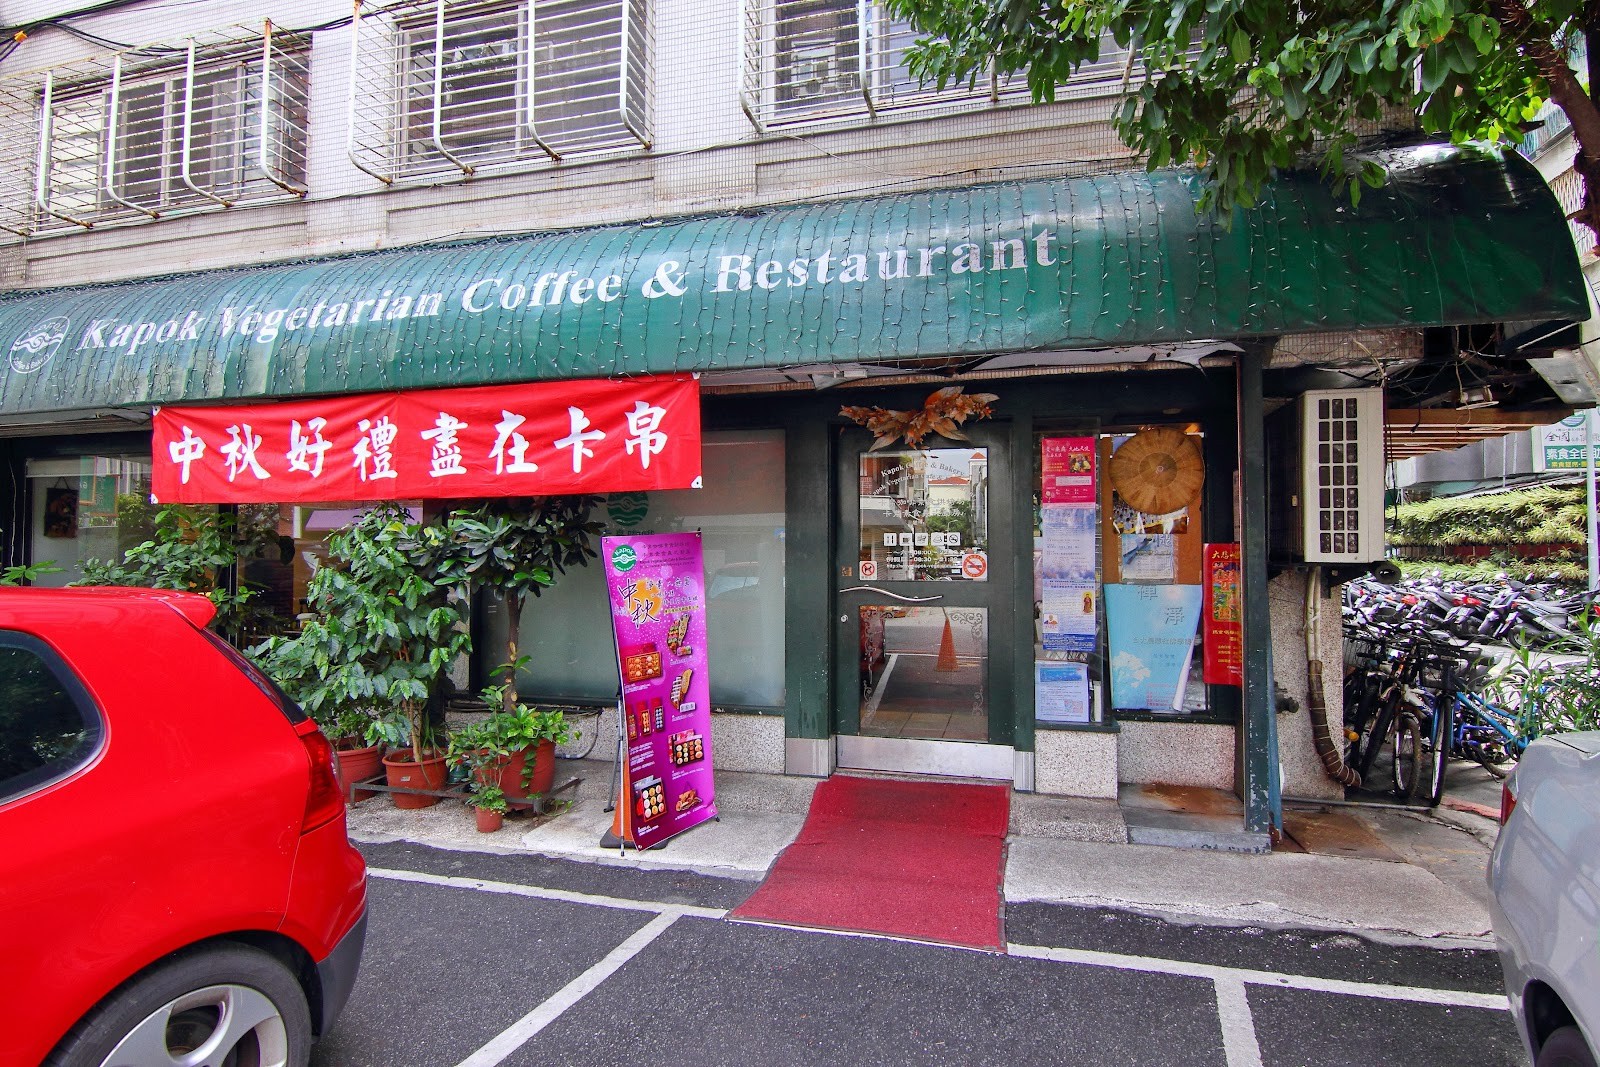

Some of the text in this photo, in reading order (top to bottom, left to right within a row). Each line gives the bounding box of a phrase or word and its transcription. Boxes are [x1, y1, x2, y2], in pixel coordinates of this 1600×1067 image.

[75, 228, 1057, 355] Kapok Vegetarian Coffee & Restaurant
[168, 400, 669, 485] 中秋好禮盡在卡帛
[881, 464, 904, 477] Kapok
[939, 463, 965, 476] Bakery
